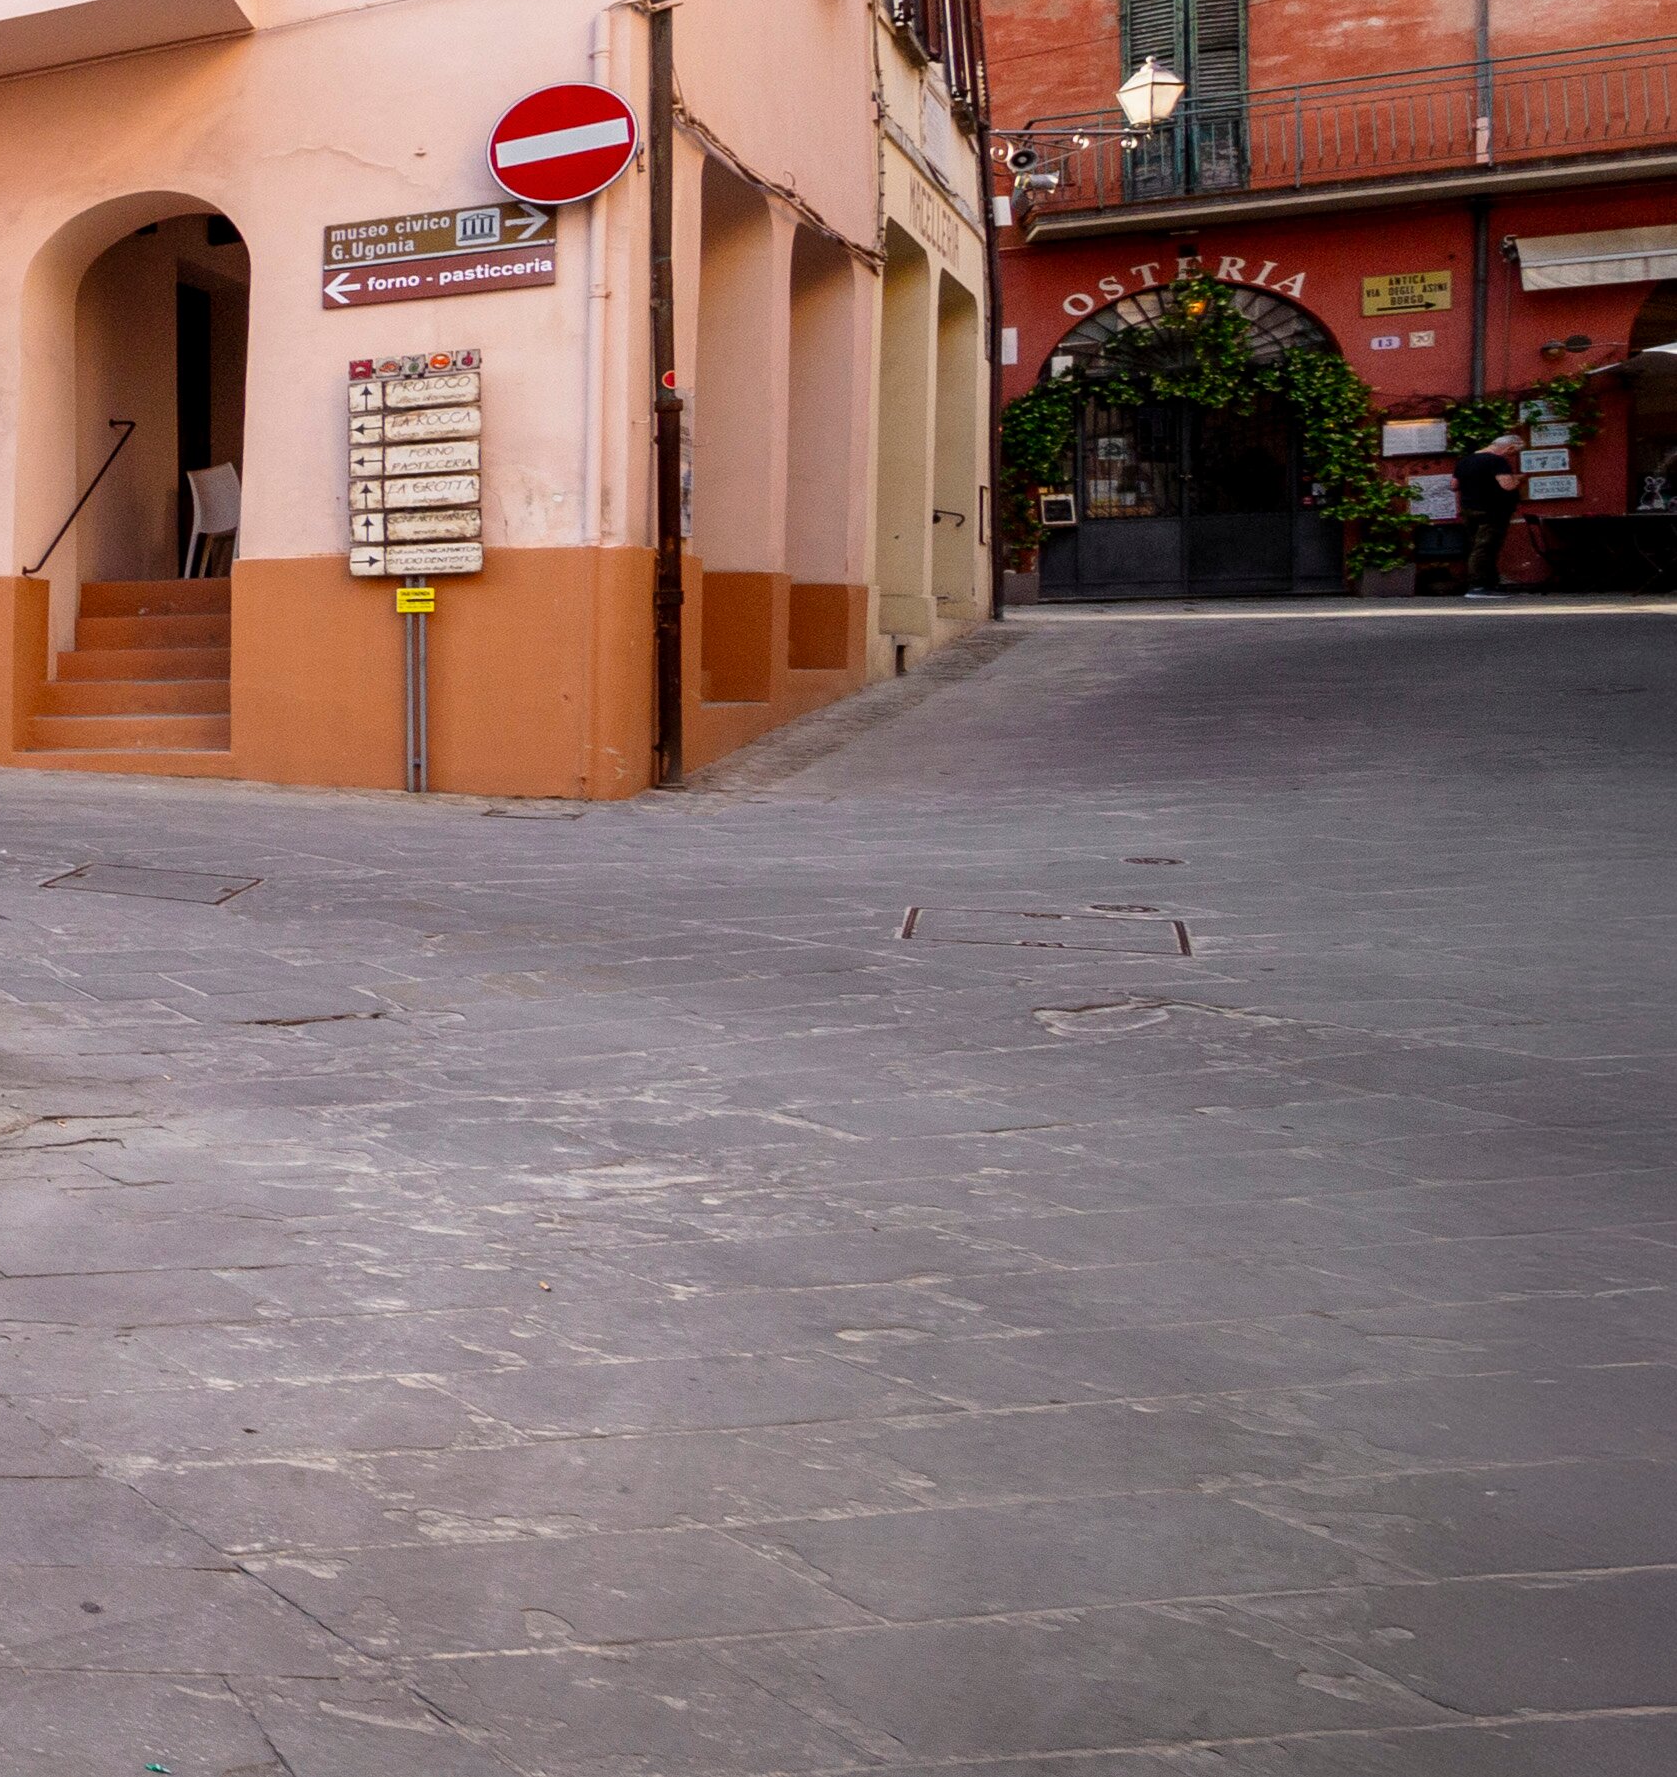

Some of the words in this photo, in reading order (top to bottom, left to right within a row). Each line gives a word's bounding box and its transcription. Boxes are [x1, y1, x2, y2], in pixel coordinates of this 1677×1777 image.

[331, 224, 388, 242] museo
[395, 215, 450, 234] civico
[909, 174, 959, 271] MACELLERIA
[332, 238, 415, 261] G.Ugonia
[367, 275, 420, 291] forno
[439, 258, 553, 285] pasticceria
[1389, 275, 1425, 286] ANTICA
[1062, 255, 1306, 316] OSTERIA
[1366, 289, 1380, 297] VIA
[1391, 295, 1424, 305] BORGO
[1378, 339, 1392, 347] 13
[416, 410, 475, 426] ROCCA
[409, 446, 454, 457] FORNO
[391, 458, 473, 472] PASTICCERIA
[388, 484, 406, 494] LA
[412, 479, 477, 493] GROTTA
